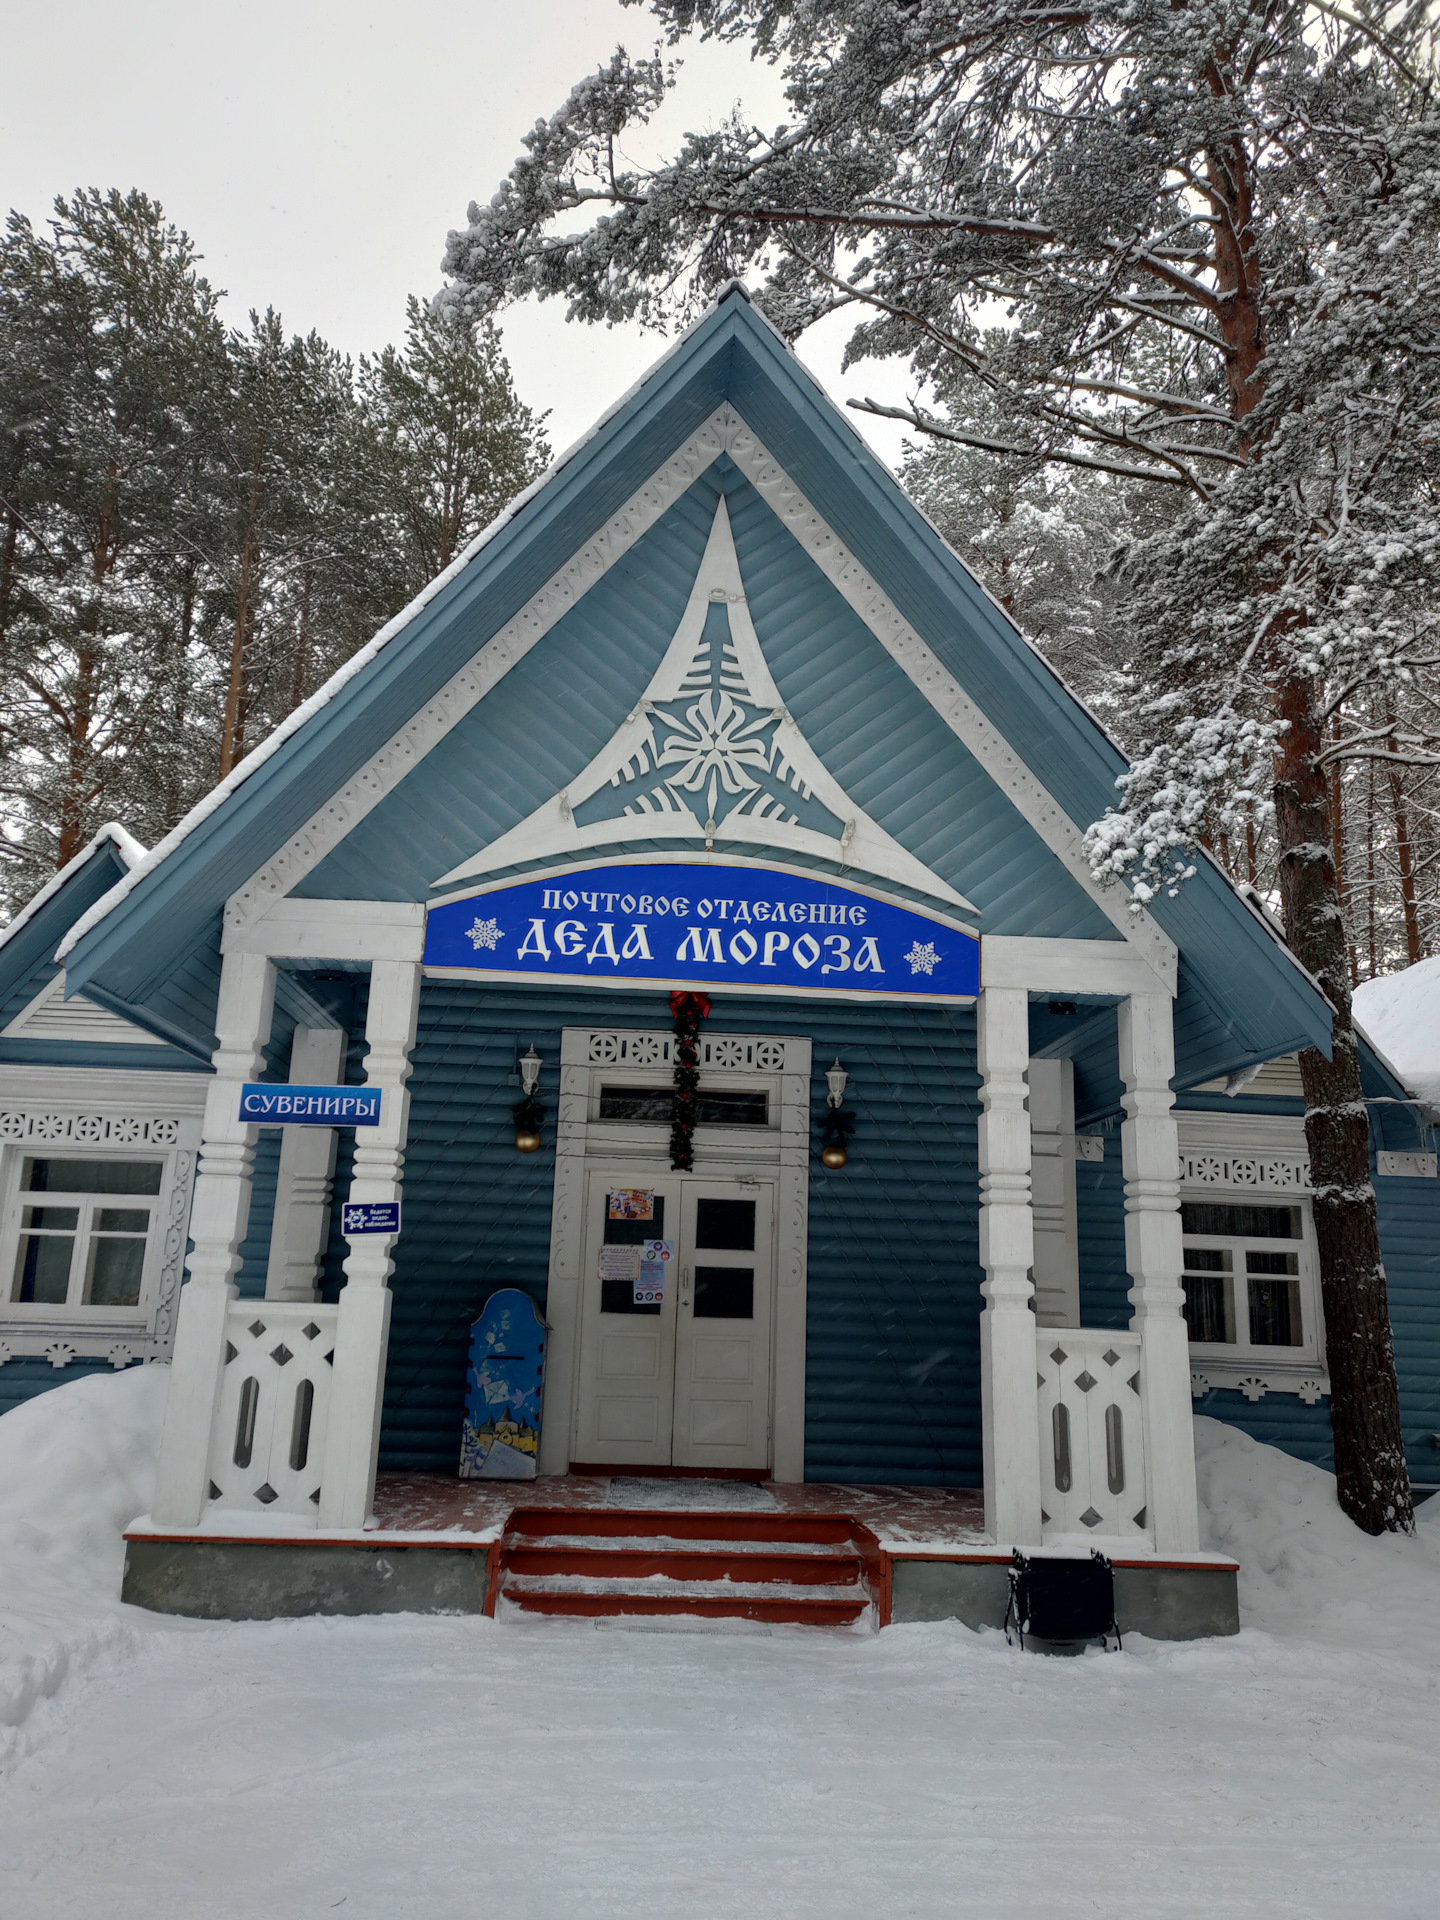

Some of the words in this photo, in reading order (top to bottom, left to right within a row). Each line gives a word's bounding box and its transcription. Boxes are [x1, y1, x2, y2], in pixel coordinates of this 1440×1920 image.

[541, 889, 690, 918] ПОЧТОВОЕ
[697, 897, 867, 926] ОТДЕЛЕНИЕ
[516, 918, 655, 966] ДЕДА
[675, 927, 886, 974] МОРОЗА
[244, 1094, 376, 1117] СУВЕНИРЫ
